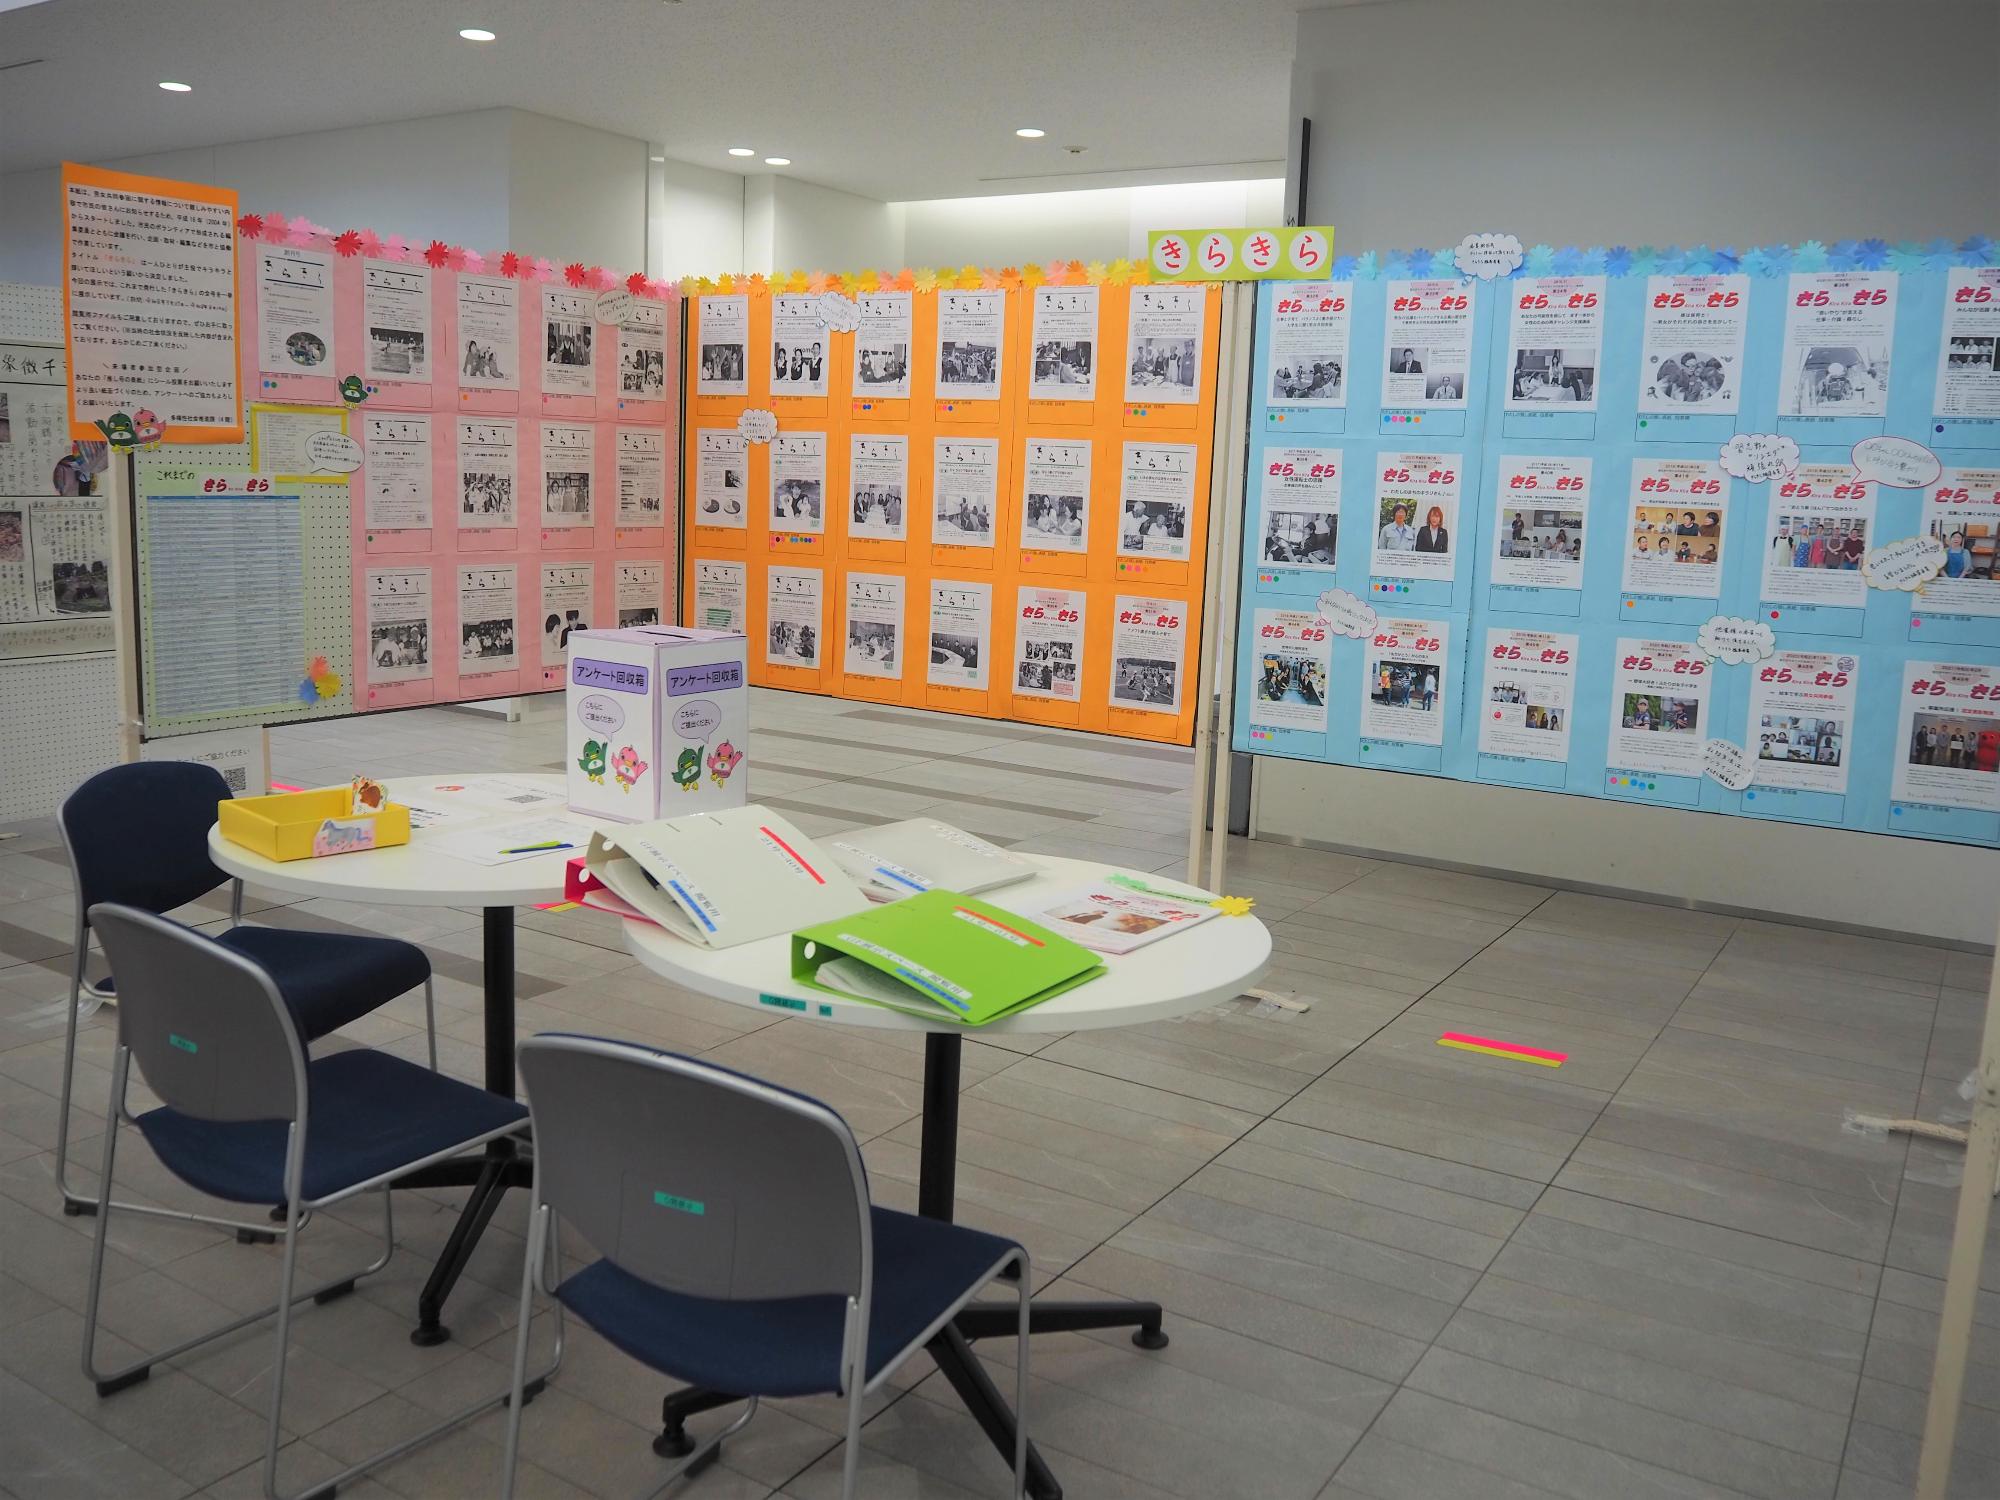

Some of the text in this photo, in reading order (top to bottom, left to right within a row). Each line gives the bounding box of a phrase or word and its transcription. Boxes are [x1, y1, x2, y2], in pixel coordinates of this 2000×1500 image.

[576, 666, 646, 687] アンケート回収箱
[670, 668, 740, 689] アンケート回収箱
[585, 701, 604, 711] こちらに
[585, 712, 617, 724] ご提出ください
[680, 708, 700, 718] こちらに
[680, 718, 714, 730] ご提出ください
